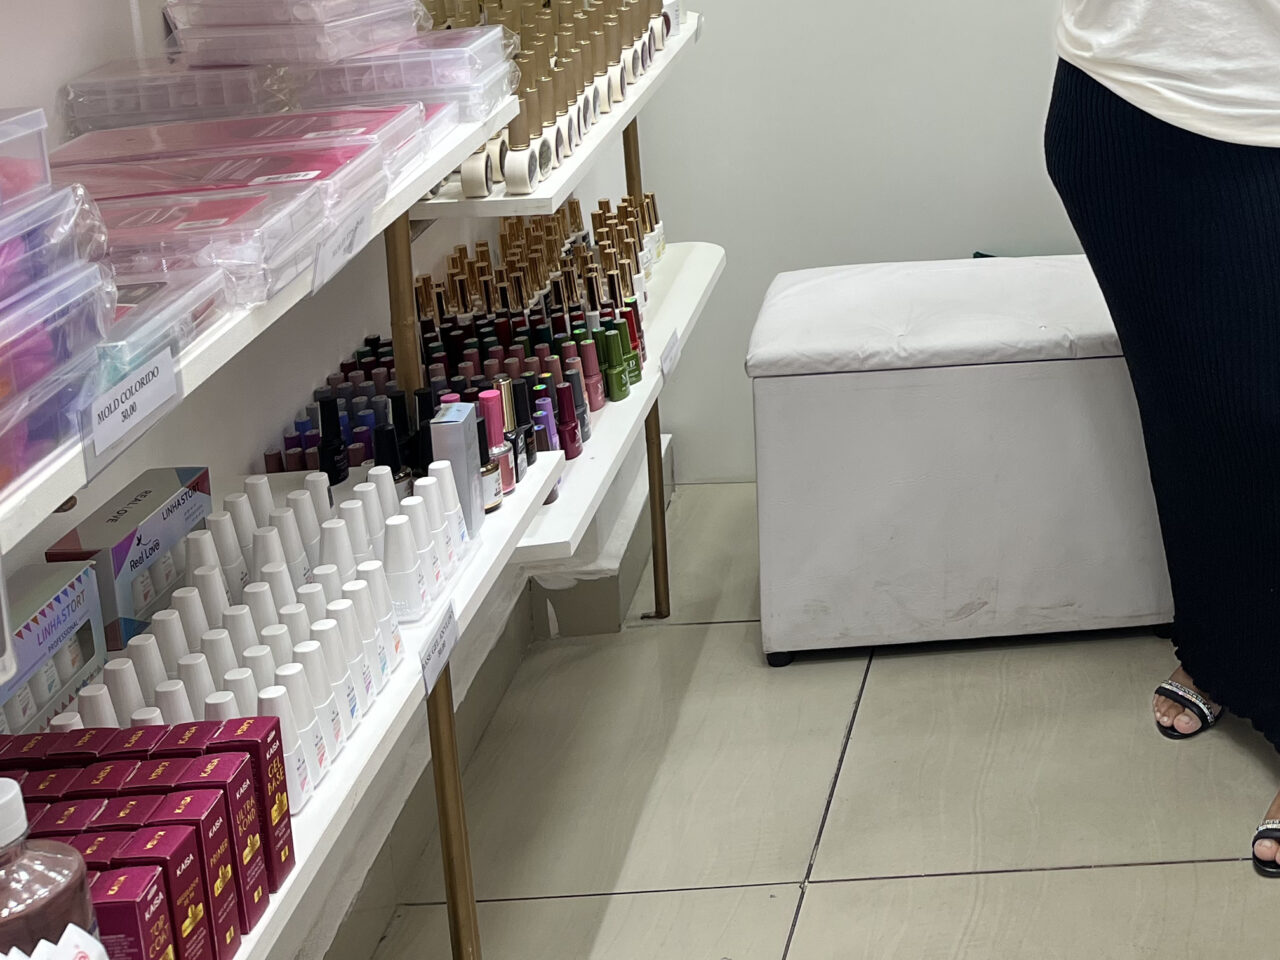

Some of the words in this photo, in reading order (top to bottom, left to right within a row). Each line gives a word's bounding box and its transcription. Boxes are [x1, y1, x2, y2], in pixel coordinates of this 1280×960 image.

[97, 398, 120, 424] MOLD
[120, 366, 160, 404] COLORIDO
[48, 620, 79, 653] PROFESSIONAL
[266, 739, 280, 761] KAISA
[200, 757, 221, 778] KAISA
[268, 756, 282, 778] GEL
[236, 778, 251, 800] KAISA
[267, 767, 285, 796] BASE
[236, 795, 256, 825] ULTRA
[238, 808, 257, 837] BOND
[208, 816, 224, 839] KAISA
[176, 853, 194, 878] KAISA
[209, 838, 228, 868] PRIMER
[144, 892, 164, 922] KAISA
[150, 914, 166, 936] TOP
